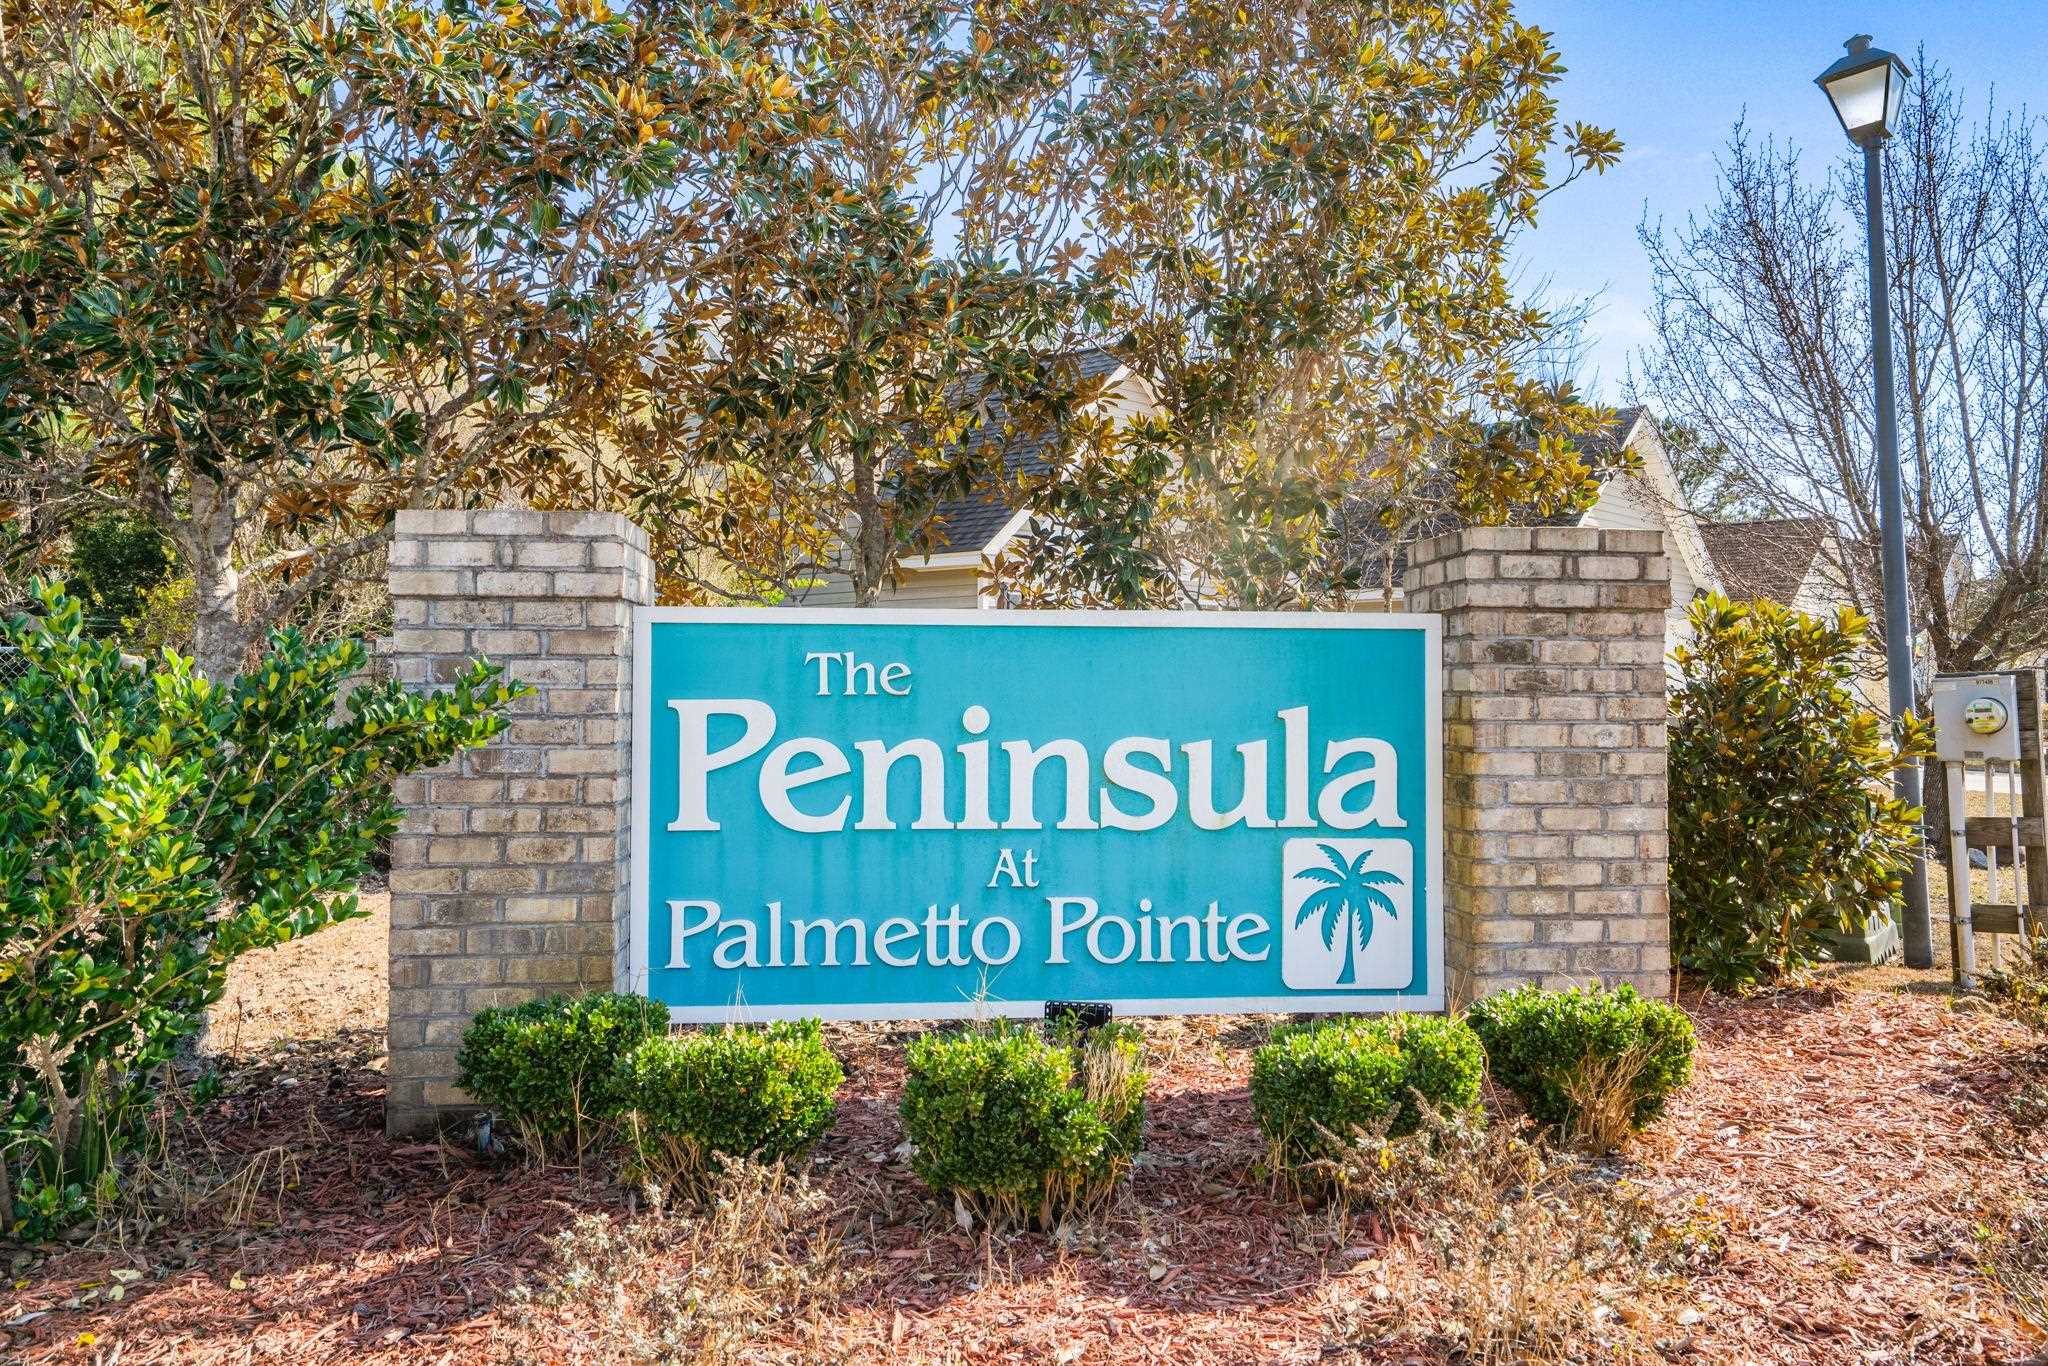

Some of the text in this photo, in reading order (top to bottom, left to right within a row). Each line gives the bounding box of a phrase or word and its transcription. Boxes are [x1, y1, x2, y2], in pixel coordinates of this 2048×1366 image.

[805, 652, 911, 697] The
[667, 699, 1408, 832] Peninsula
[987, 848, 1040, 888] At
[664, 896, 1271, 969] Palmetto Pointe
